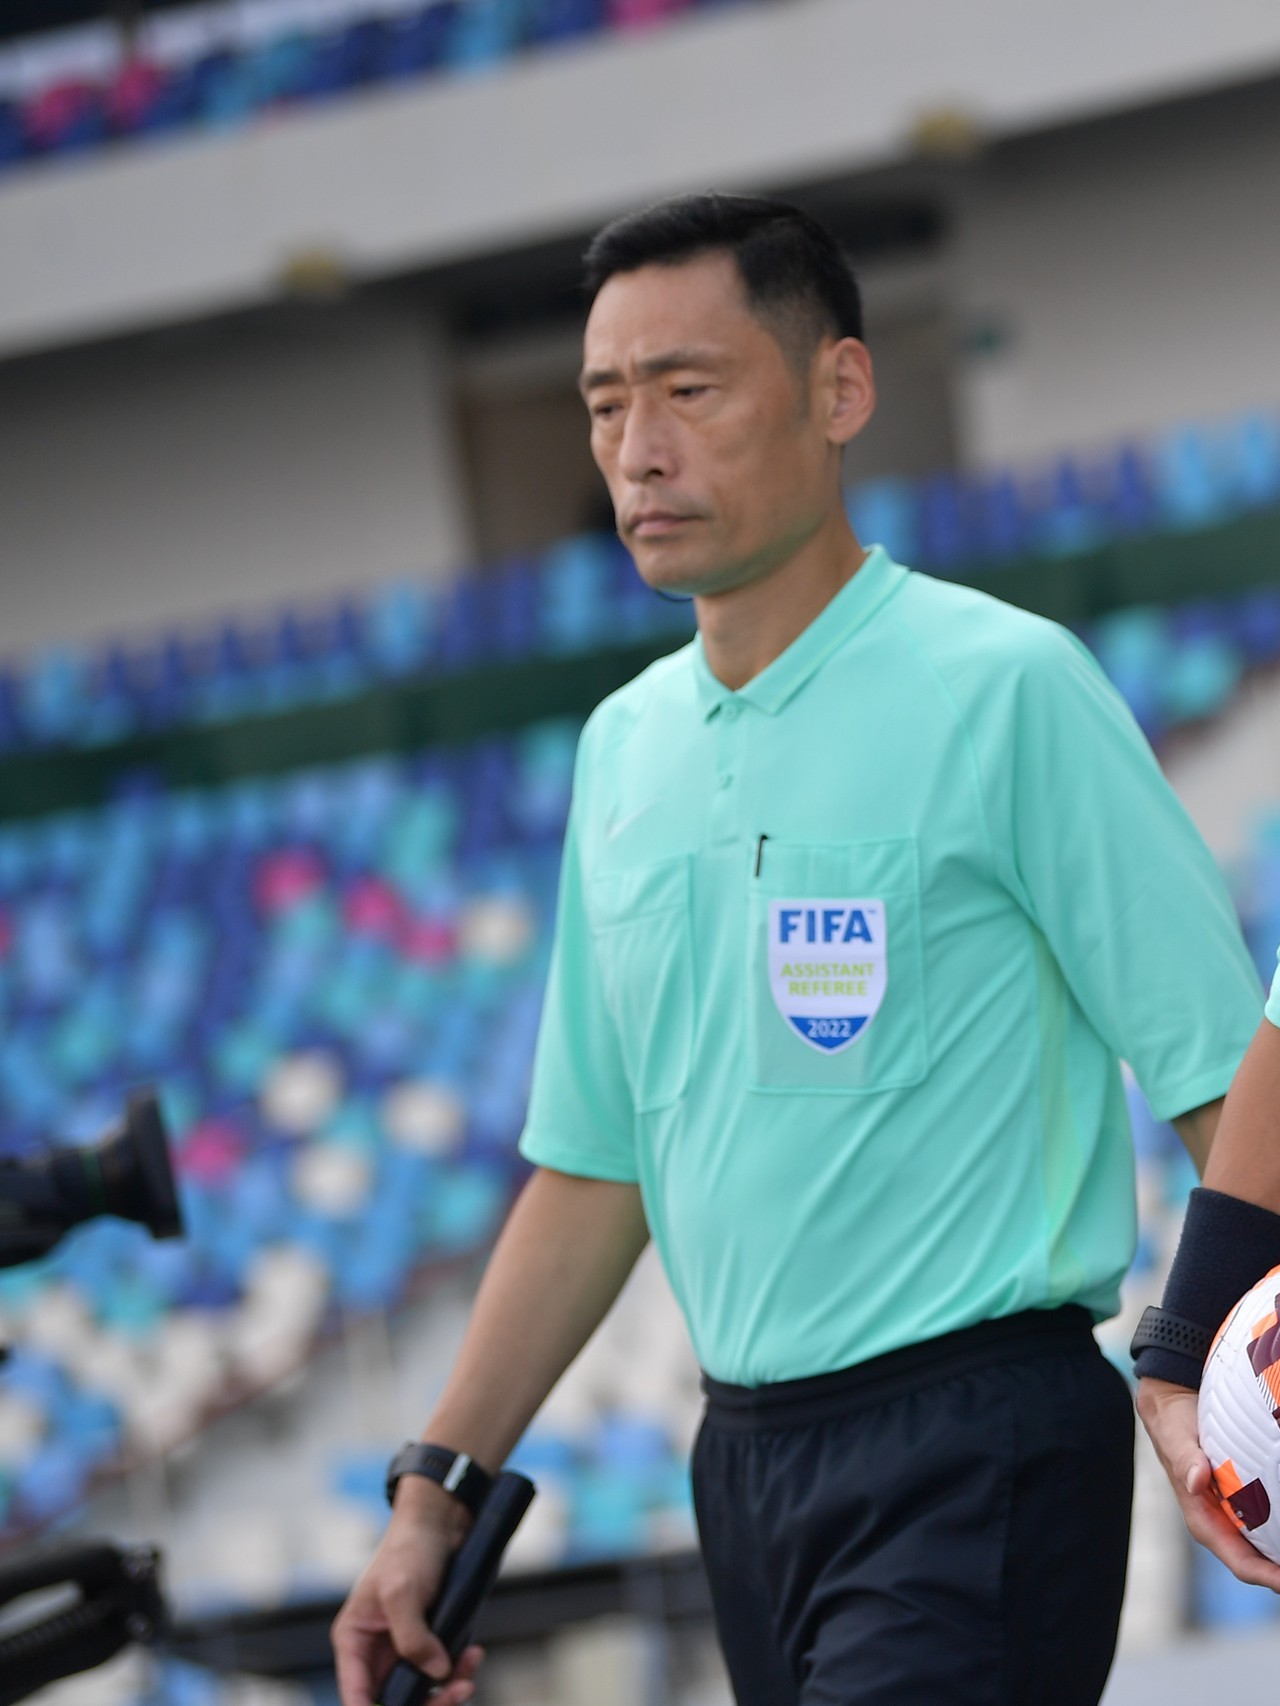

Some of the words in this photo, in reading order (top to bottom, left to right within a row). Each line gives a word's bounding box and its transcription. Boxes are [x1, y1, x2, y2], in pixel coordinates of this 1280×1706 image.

[779, 909, 873, 943] FIFA
[781, 963, 874, 978] ASSISTANT
[788, 980, 868, 996] REFEREE
[807, 1019, 851, 1038] 2022
